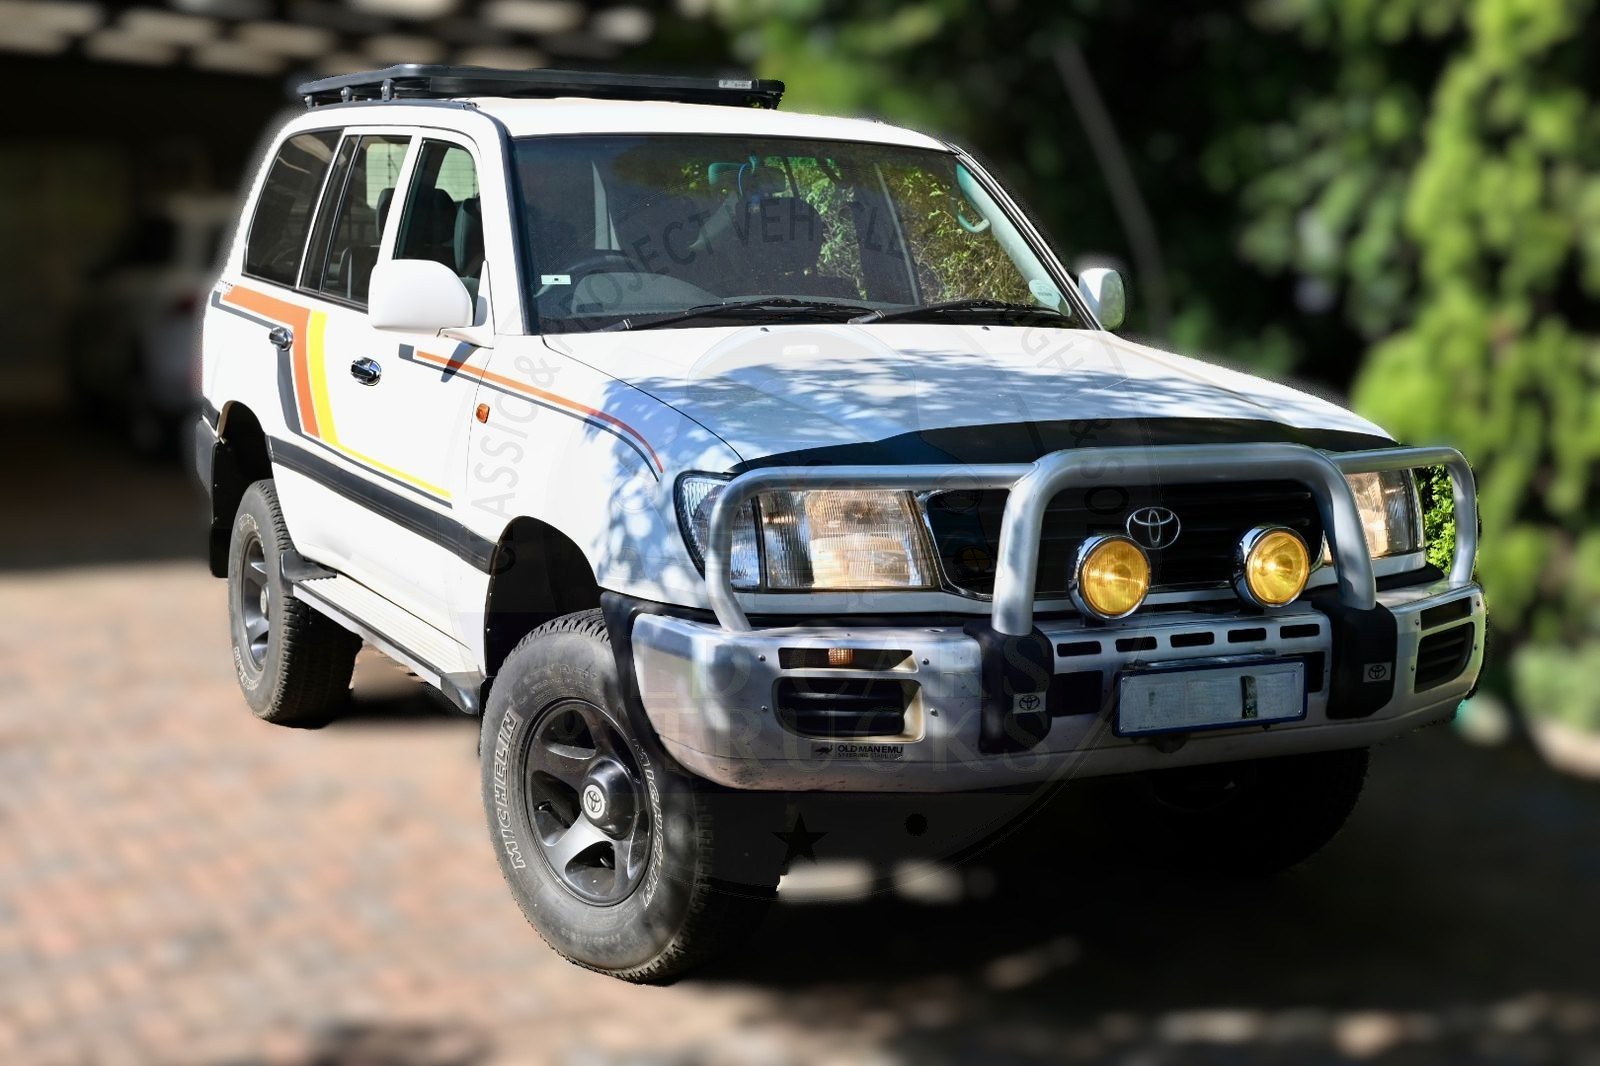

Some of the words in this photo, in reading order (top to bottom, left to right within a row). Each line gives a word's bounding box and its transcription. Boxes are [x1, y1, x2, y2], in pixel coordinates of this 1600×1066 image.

[494, 710, 526, 869] MICHELIN
[837, 744, 858, 753] OLD
[858, 745, 880, 754] MAN
[881, 745, 903, 754] EMU
